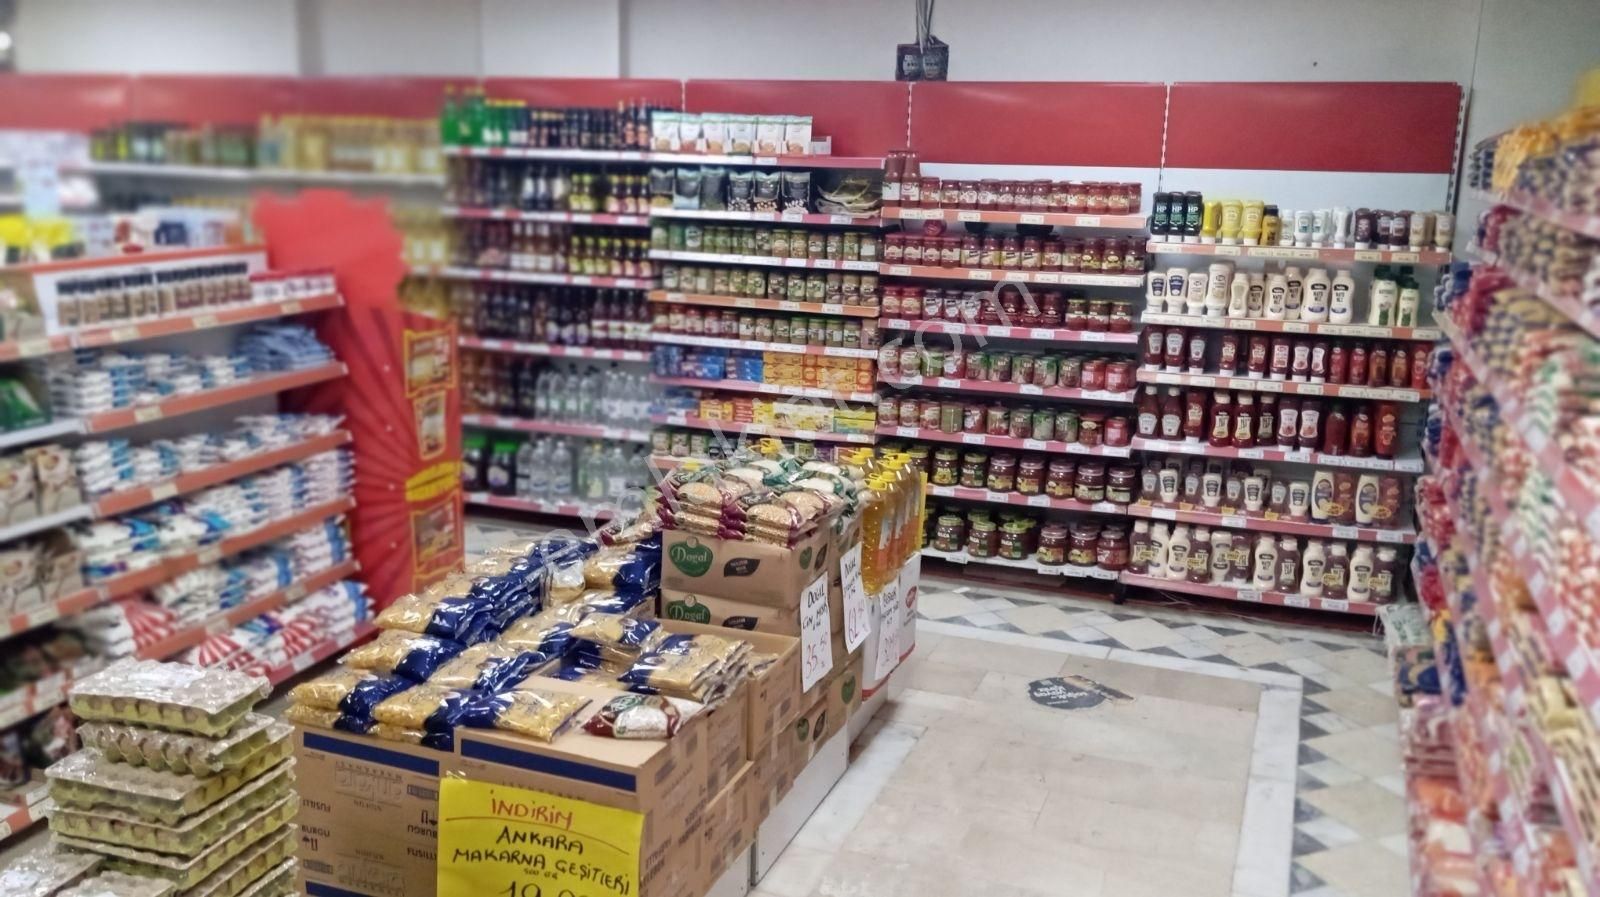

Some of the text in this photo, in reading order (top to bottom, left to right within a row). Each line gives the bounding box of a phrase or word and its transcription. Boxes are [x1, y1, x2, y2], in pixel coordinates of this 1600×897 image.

[489, 789, 573, 830] İNDİRİM
[496, 825, 583, 855] ANKARA
[453, 848, 546, 870] MAKARNA
